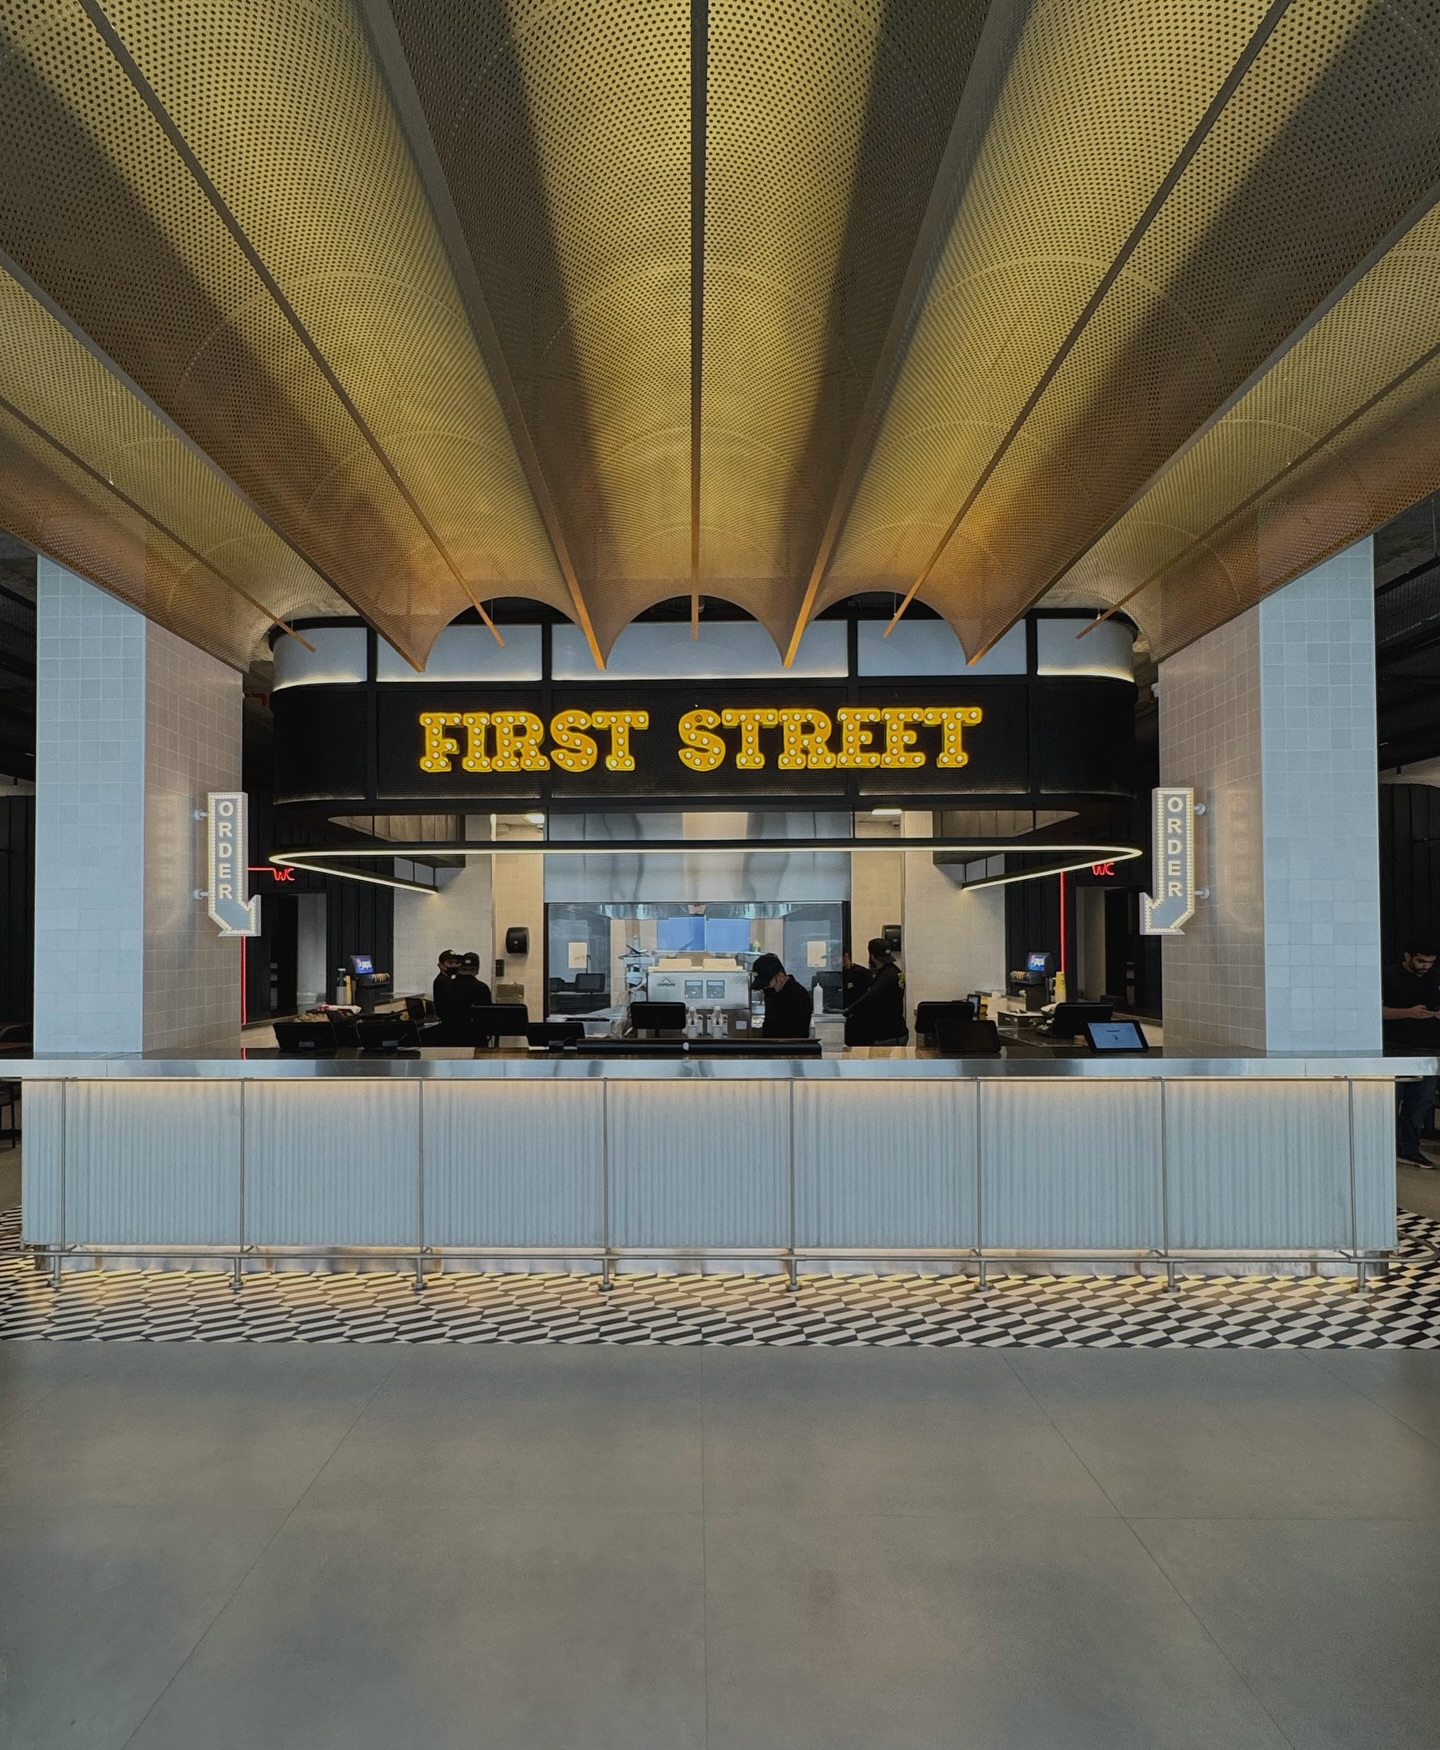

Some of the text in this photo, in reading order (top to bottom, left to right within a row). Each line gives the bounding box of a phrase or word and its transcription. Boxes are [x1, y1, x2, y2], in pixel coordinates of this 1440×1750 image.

[419, 708, 983, 772] FIRST STREET
[218, 801, 234, 900] ORDER
[273, 868, 295, 881] WC
[1092, 862, 1115, 876] WC
[1167, 796, 1184, 897] ORDER
